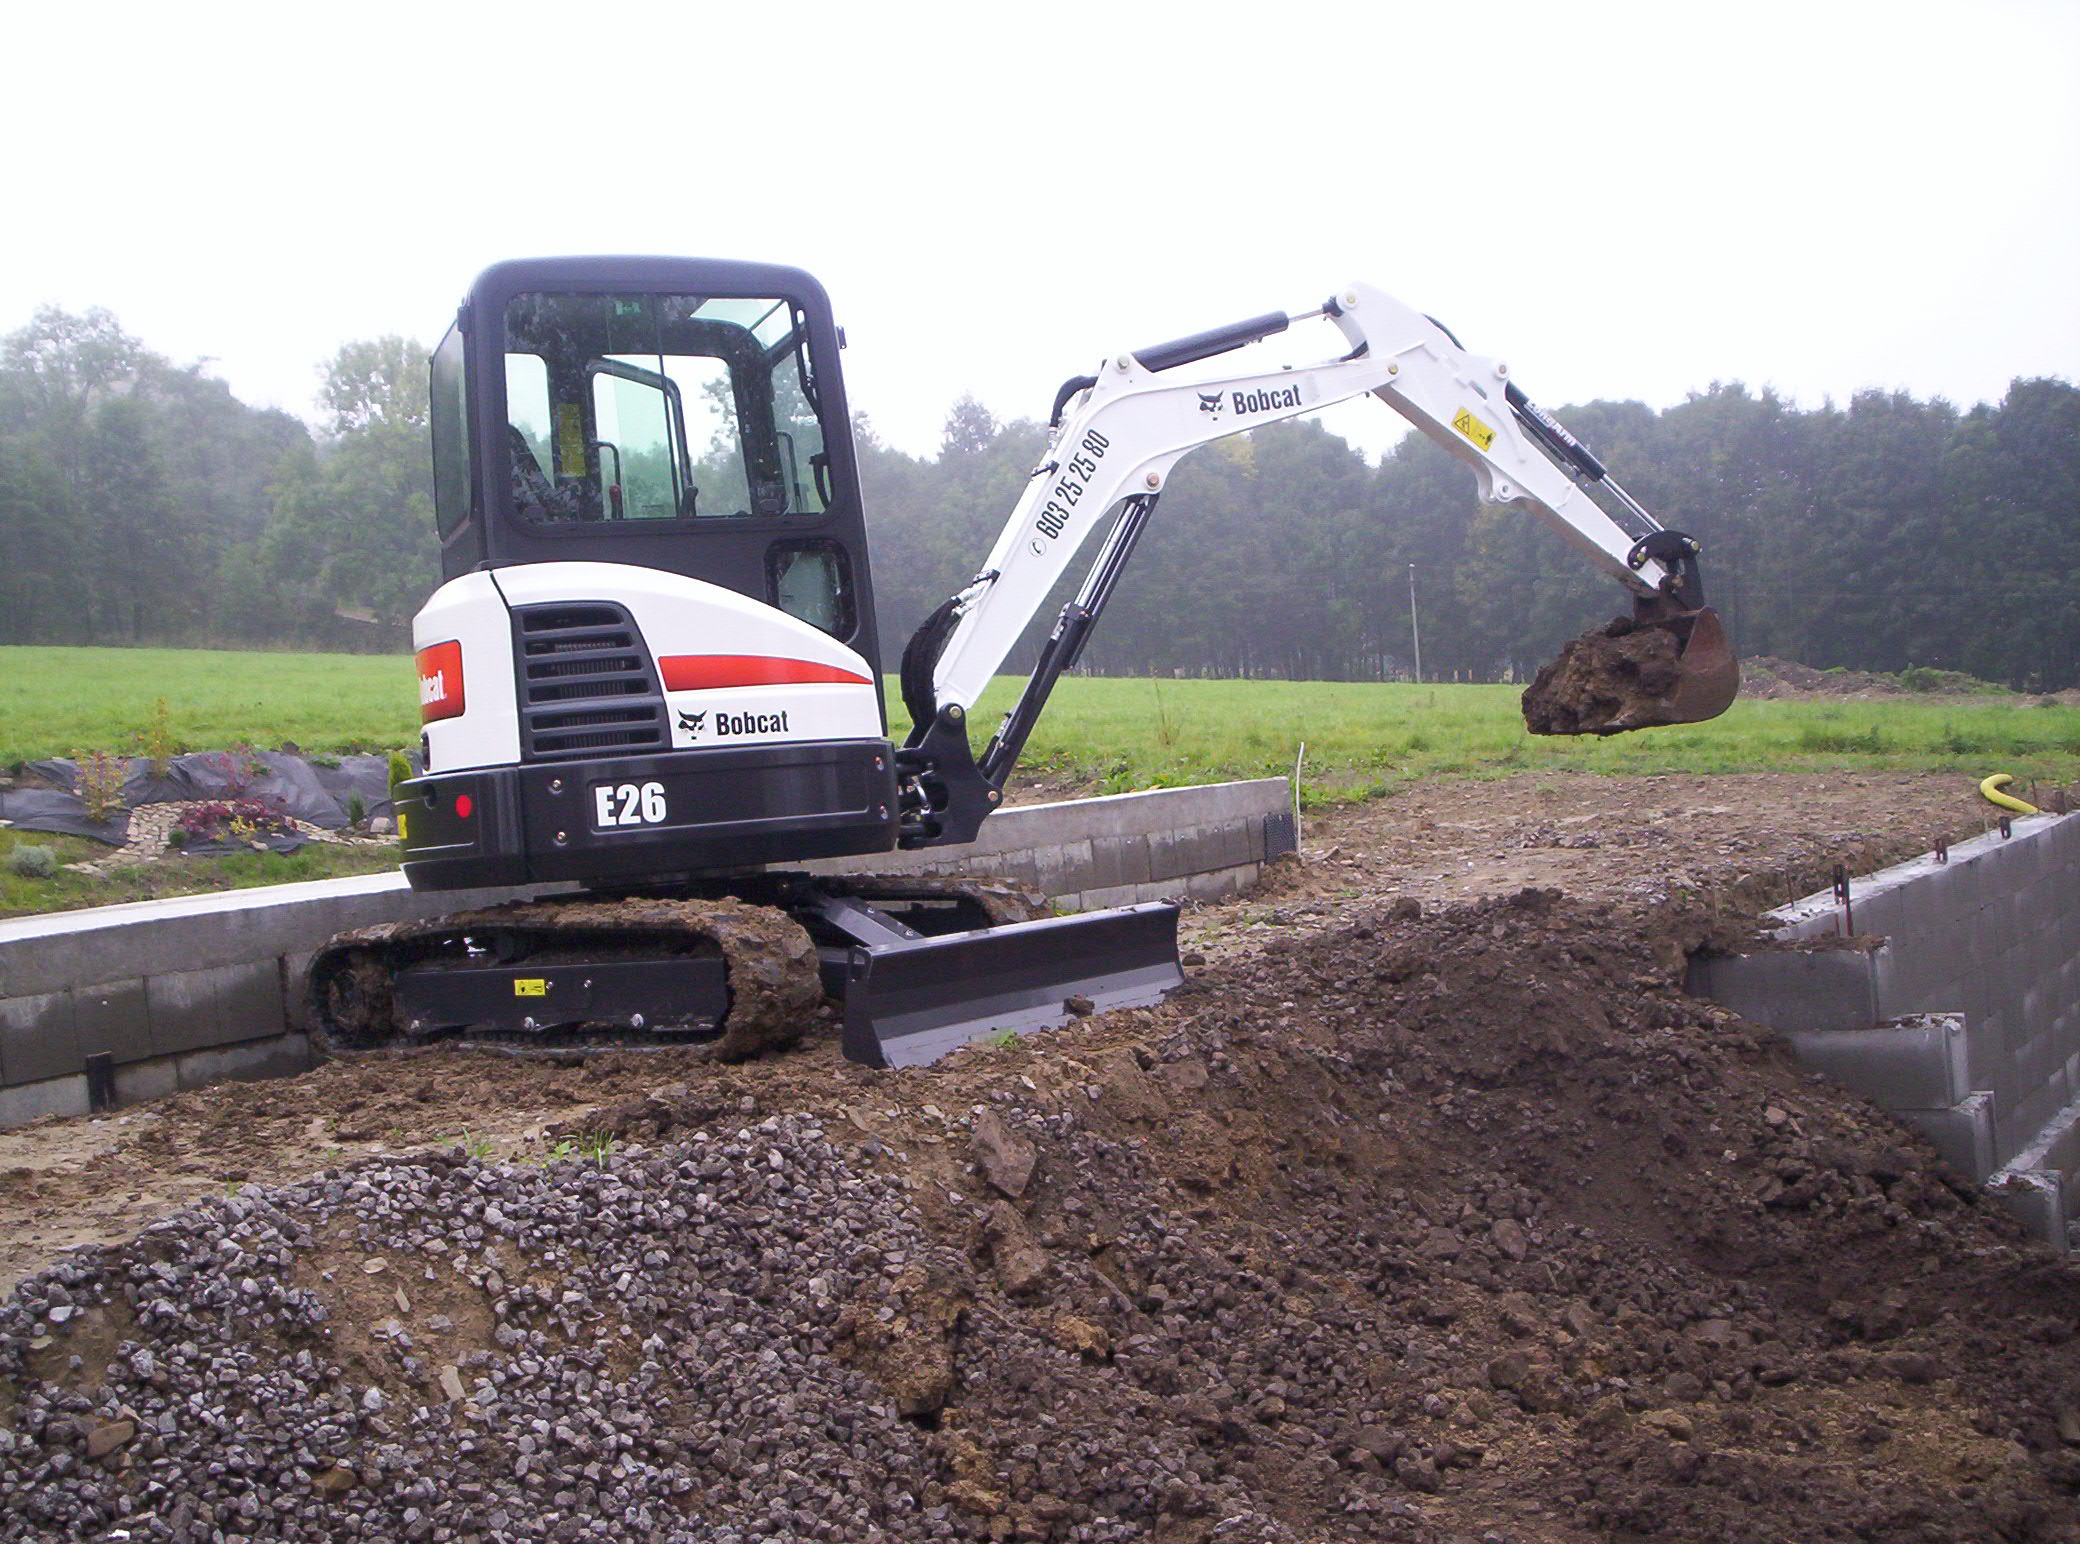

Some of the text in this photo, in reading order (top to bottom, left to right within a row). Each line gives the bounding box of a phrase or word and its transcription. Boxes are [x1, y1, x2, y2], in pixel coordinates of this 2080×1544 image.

[1232, 384, 1302, 415] Bobcat
[1035, 429, 1110, 540] 603 25 25 80
[715, 710, 790, 736] Bobcat
[595, 781, 667, 827] E26
